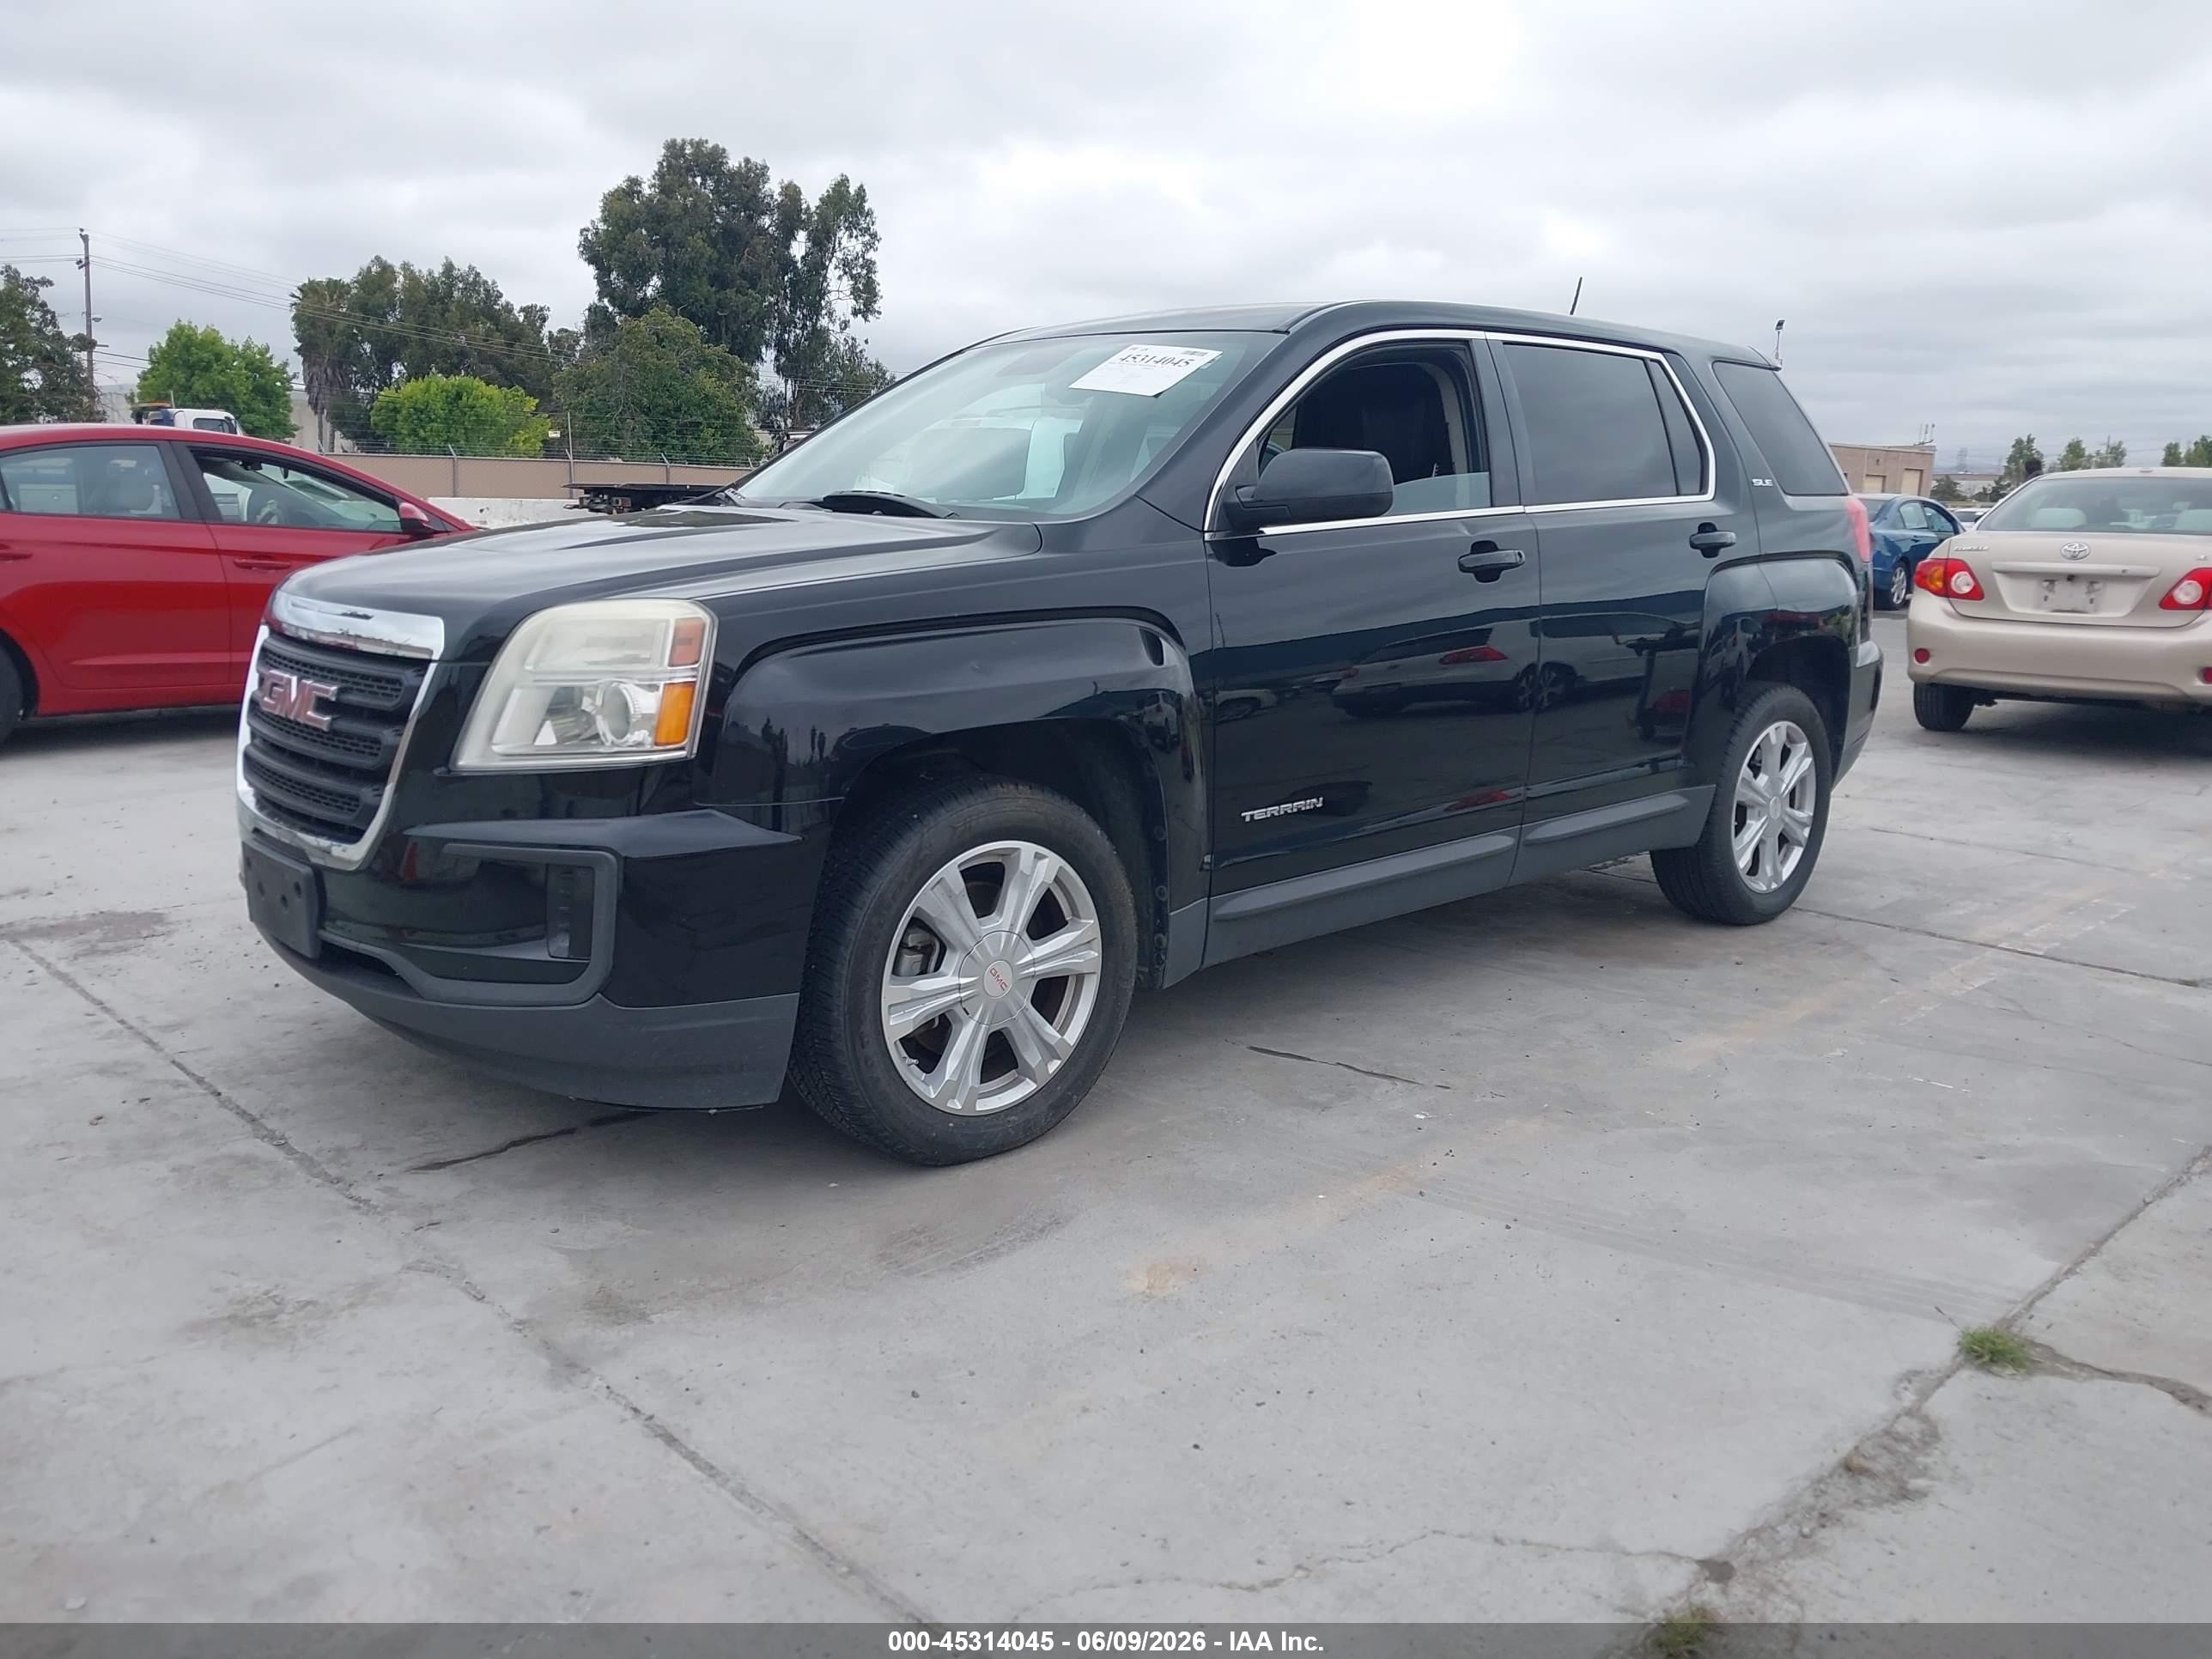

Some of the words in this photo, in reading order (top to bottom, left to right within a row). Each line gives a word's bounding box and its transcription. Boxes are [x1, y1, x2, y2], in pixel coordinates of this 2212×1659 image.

[1119, 353, 1196, 368] 45314045
[259, 669, 338, 732] GMC
[1241, 797, 1323, 822] TERRAIN
[989, 967, 1008, 992] GMC
